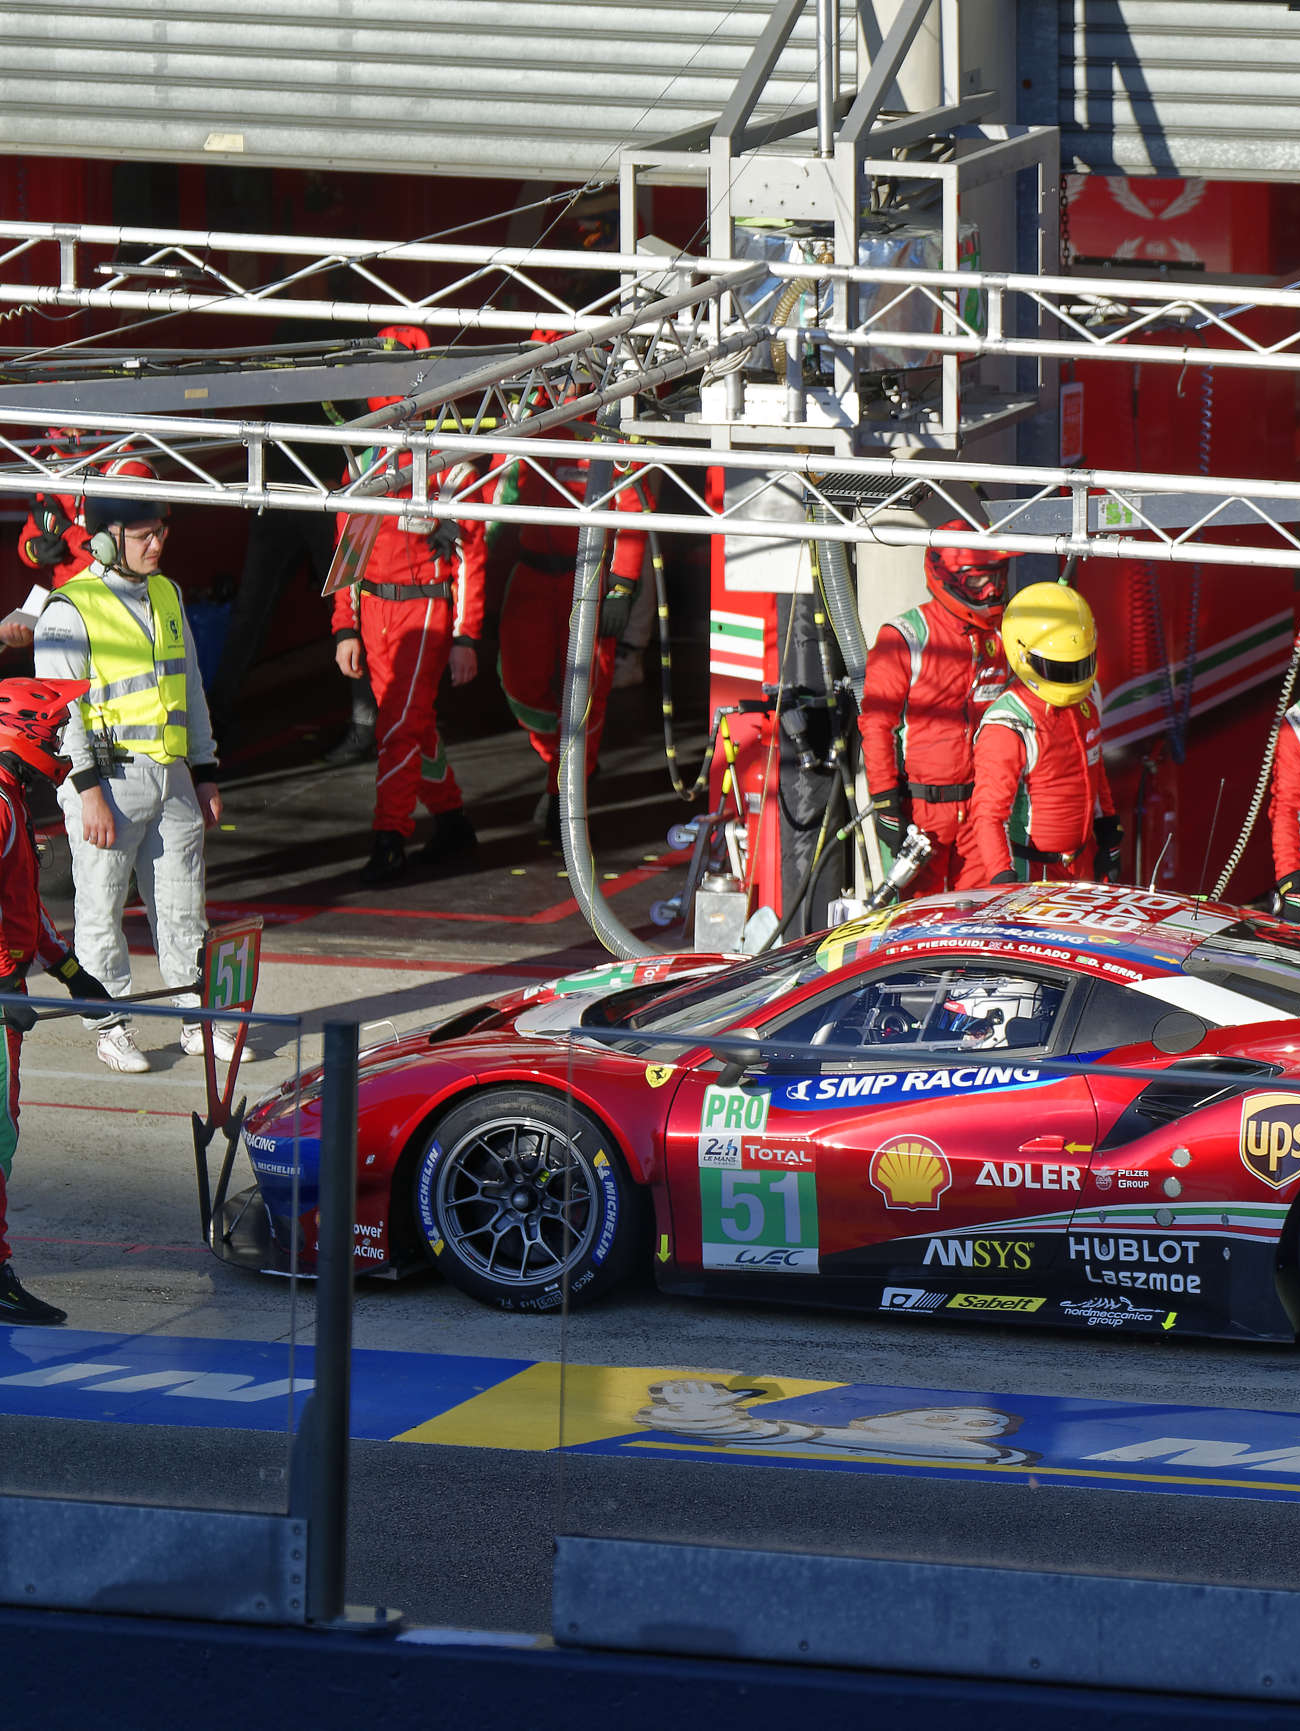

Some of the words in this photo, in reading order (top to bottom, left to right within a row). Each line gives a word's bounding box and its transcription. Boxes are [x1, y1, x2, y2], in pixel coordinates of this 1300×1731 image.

[900, 944, 913, 952] A.
[917, 940, 984, 950] PIERGUIDI
[1003, 942, 1014, 950] J.
[1018, 944, 1071, 960] CALADO
[214, 935, 250, 1009] 51
[1088, 957, 1100, 968] D.
[1102, 962, 1143, 982] SERRA
[816, 1074, 898, 1099] SMP
[901, 1066, 1040, 1092] RACING
[705, 1094, 764, 1129] PRO
[744, 1145, 812, 1163] TOTAL
[257, 1161, 301, 1176] MICHELIN
[975, 1161, 1081, 1191] ADLER
[1117, 1168, 1149, 1178] PELZER
[419, 1147, 439, 1226] MICHELIN
[1117, 1179, 1149, 1189] GROUP
[720, 1170, 802, 1244] 51
[597, 1180, 617, 1260] MICHELIN
[353, 1223, 382, 1238] ower
[353, 1244, 384, 1260] ACING
[734, 1249, 805, 1267] WEC
[922, 1238, 1031, 1271] ANSYS
[1068, 1236, 1200, 1264] HUBLOT
[1085, 1264, 1201, 1294] Laszmoe
[958, 1295, 1035, 1310] Sabelt
[1064, 1306, 1153, 1321] nordmeccanica
[1087, 1317, 1124, 1327] group
